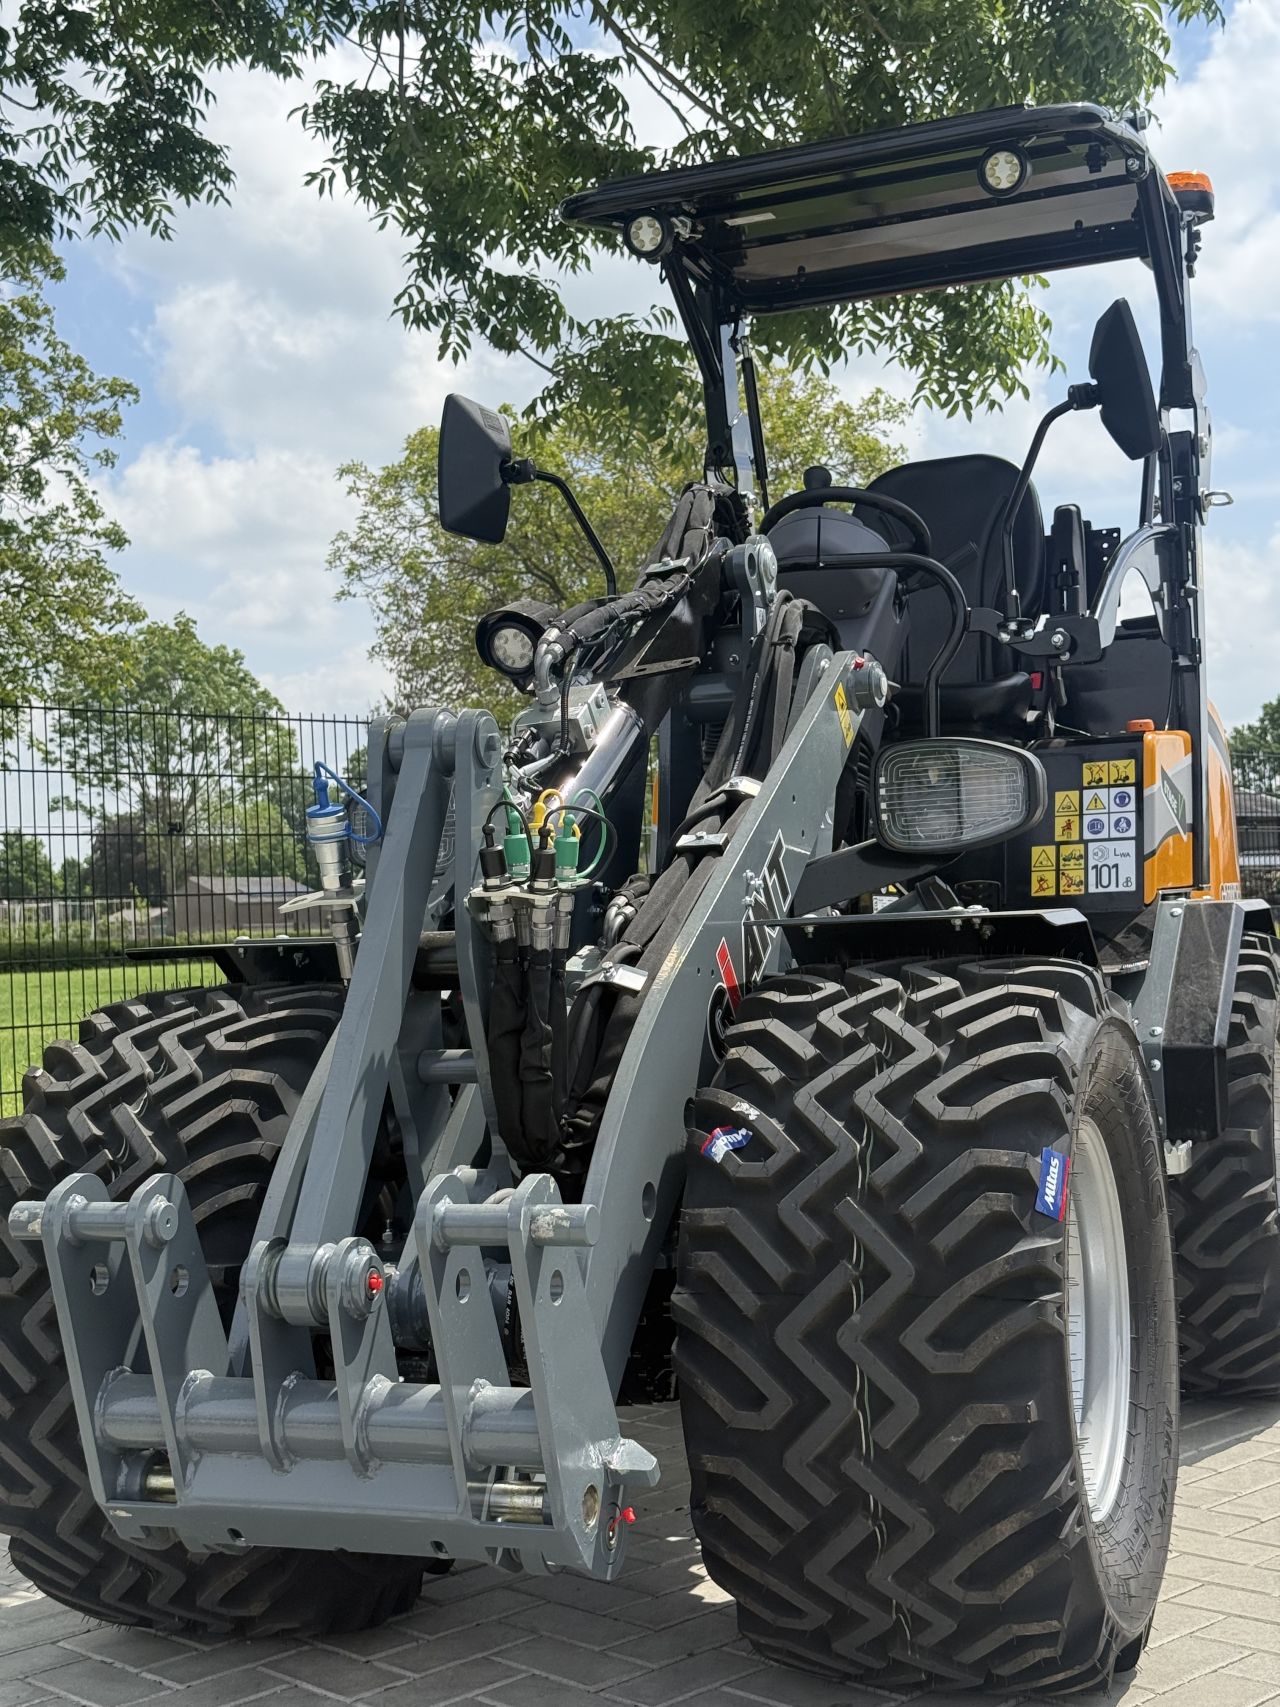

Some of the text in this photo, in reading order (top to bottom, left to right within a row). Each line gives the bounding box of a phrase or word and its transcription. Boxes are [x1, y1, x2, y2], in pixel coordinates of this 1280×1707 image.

[1091, 863, 1133, 889] 101 dB
[1044, 1156, 1060, 1211] Mitas
